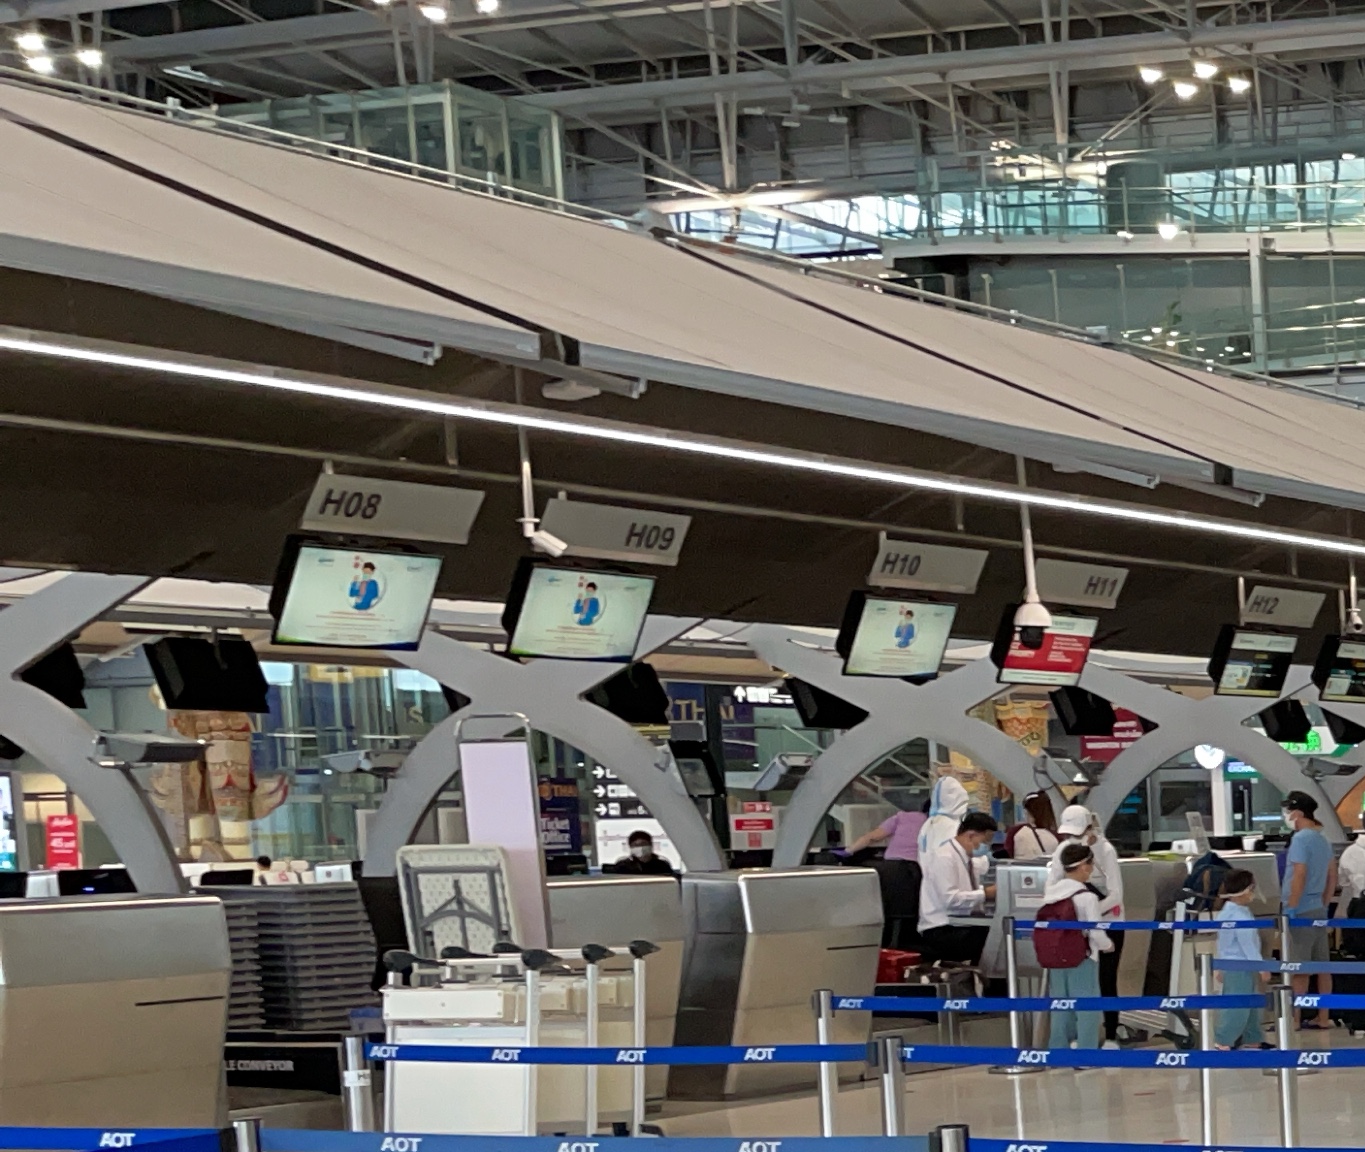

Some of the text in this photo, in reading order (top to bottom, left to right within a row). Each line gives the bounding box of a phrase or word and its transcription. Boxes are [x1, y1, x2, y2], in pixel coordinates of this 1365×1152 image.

[319, 489, 382, 519] H08
[626, 524, 674, 551] H09
[881, 553, 922, 577] H10
[1084, 576, 1118, 597] H11
[1249, 594, 1280, 615] H12
[1280, 962, 1302, 972] AOT
[838, 999, 864, 1010] AOT
[943, 999, 969, 1010] AOT
[1050, 999, 1077, 1010] AOT
[1159, 998, 1188, 1009] AOT
[1294, 995, 1320, 1007] AOT
[369, 1046, 400, 1060] AOT
[491, 1048, 521, 1062] AOT
[616, 1050, 646, 1062] AOT
[744, 1047, 776, 1062] AOT
[1017, 1050, 1050, 1064] AOT
[1155, 1052, 1190, 1066] AOT
[1297, 1052, 1332, 1066] AOT
[237, 1060, 294, 1071] CONVEYOR
[100, 1132, 136, 1148] AOT
[380, 1137, 423, 1152] AOT
